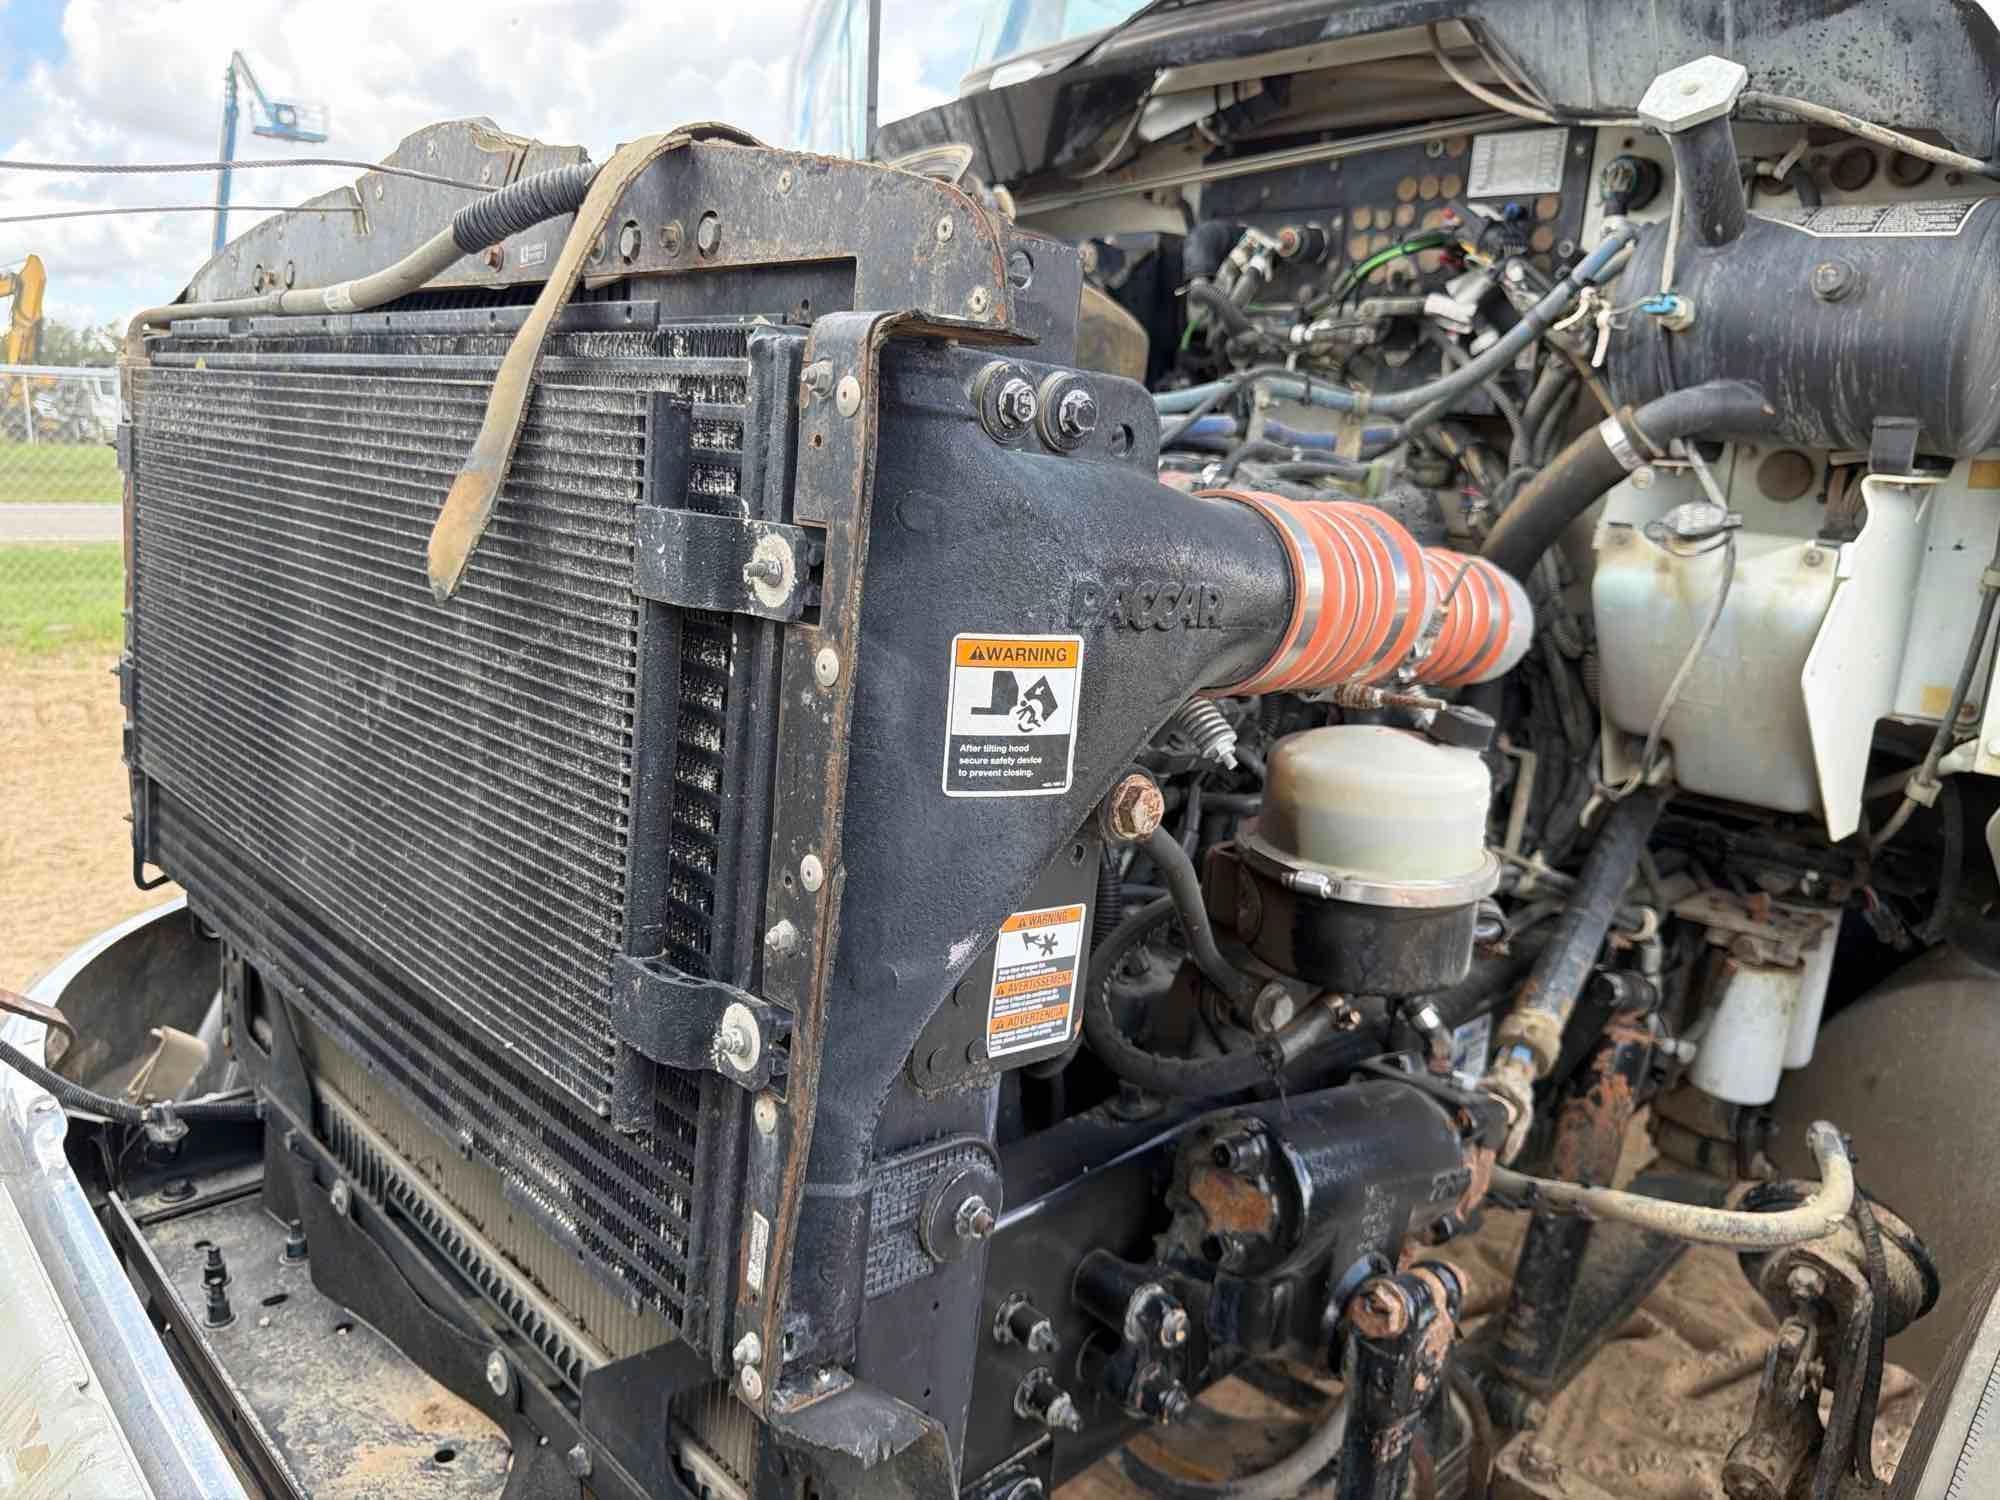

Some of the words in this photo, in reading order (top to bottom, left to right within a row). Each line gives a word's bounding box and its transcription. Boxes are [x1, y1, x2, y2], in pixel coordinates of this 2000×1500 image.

[1072, 580, 1224, 631] PACCAR
[986, 647, 1067, 662] WARNING
[960, 744, 981, 753] After
[983, 744, 1007, 754] tilting
[1008, 744, 1030, 753] hood
[959, 757, 989, 765] secure
[990, 756, 1016, 766] safety
[1016, 756, 1043, 765] device
[958, 769, 968, 777] to
[969, 769, 1001, 778] prevent
[1002, 769, 1034, 778] closing.
[1028, 911, 1068, 926] WARNING
[1007, 972, 1072, 993] AVERTISSEMENT
